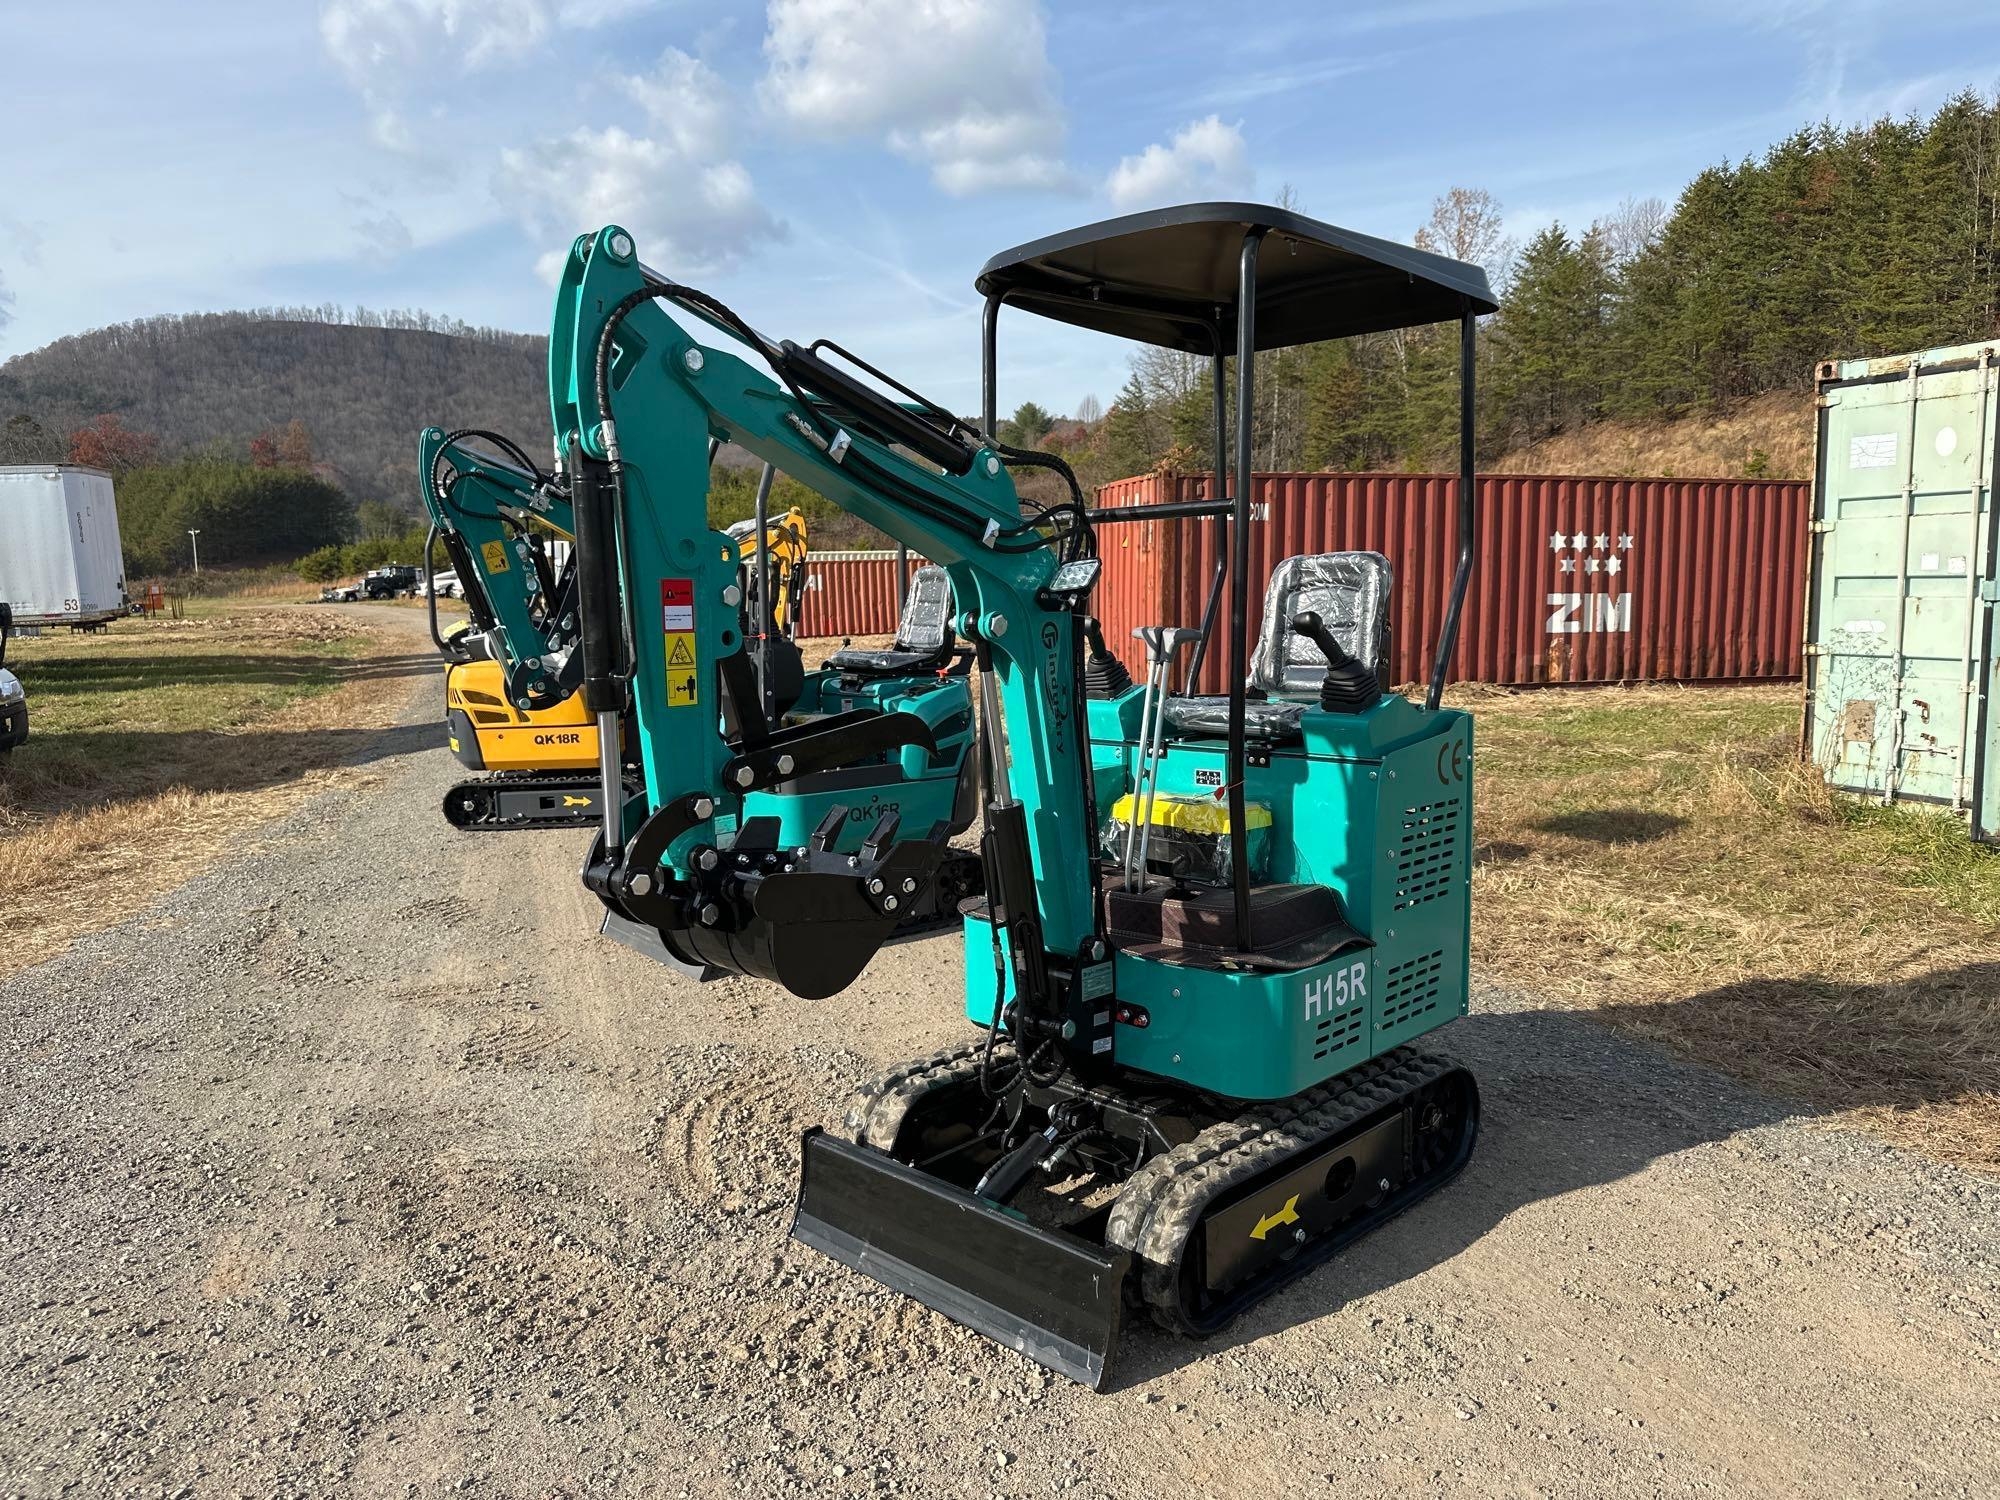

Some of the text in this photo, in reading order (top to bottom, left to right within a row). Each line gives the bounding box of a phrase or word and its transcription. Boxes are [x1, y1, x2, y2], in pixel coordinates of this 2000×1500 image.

[64, 599, 79, 612] 53
[1545, 592, 1632, 633] ZIM
[534, 733, 580, 745] QK18R
[1437, 739, 1463, 785] CE
[850, 803, 900, 822] QK16R
[1305, 962, 1367, 1021] H15R
